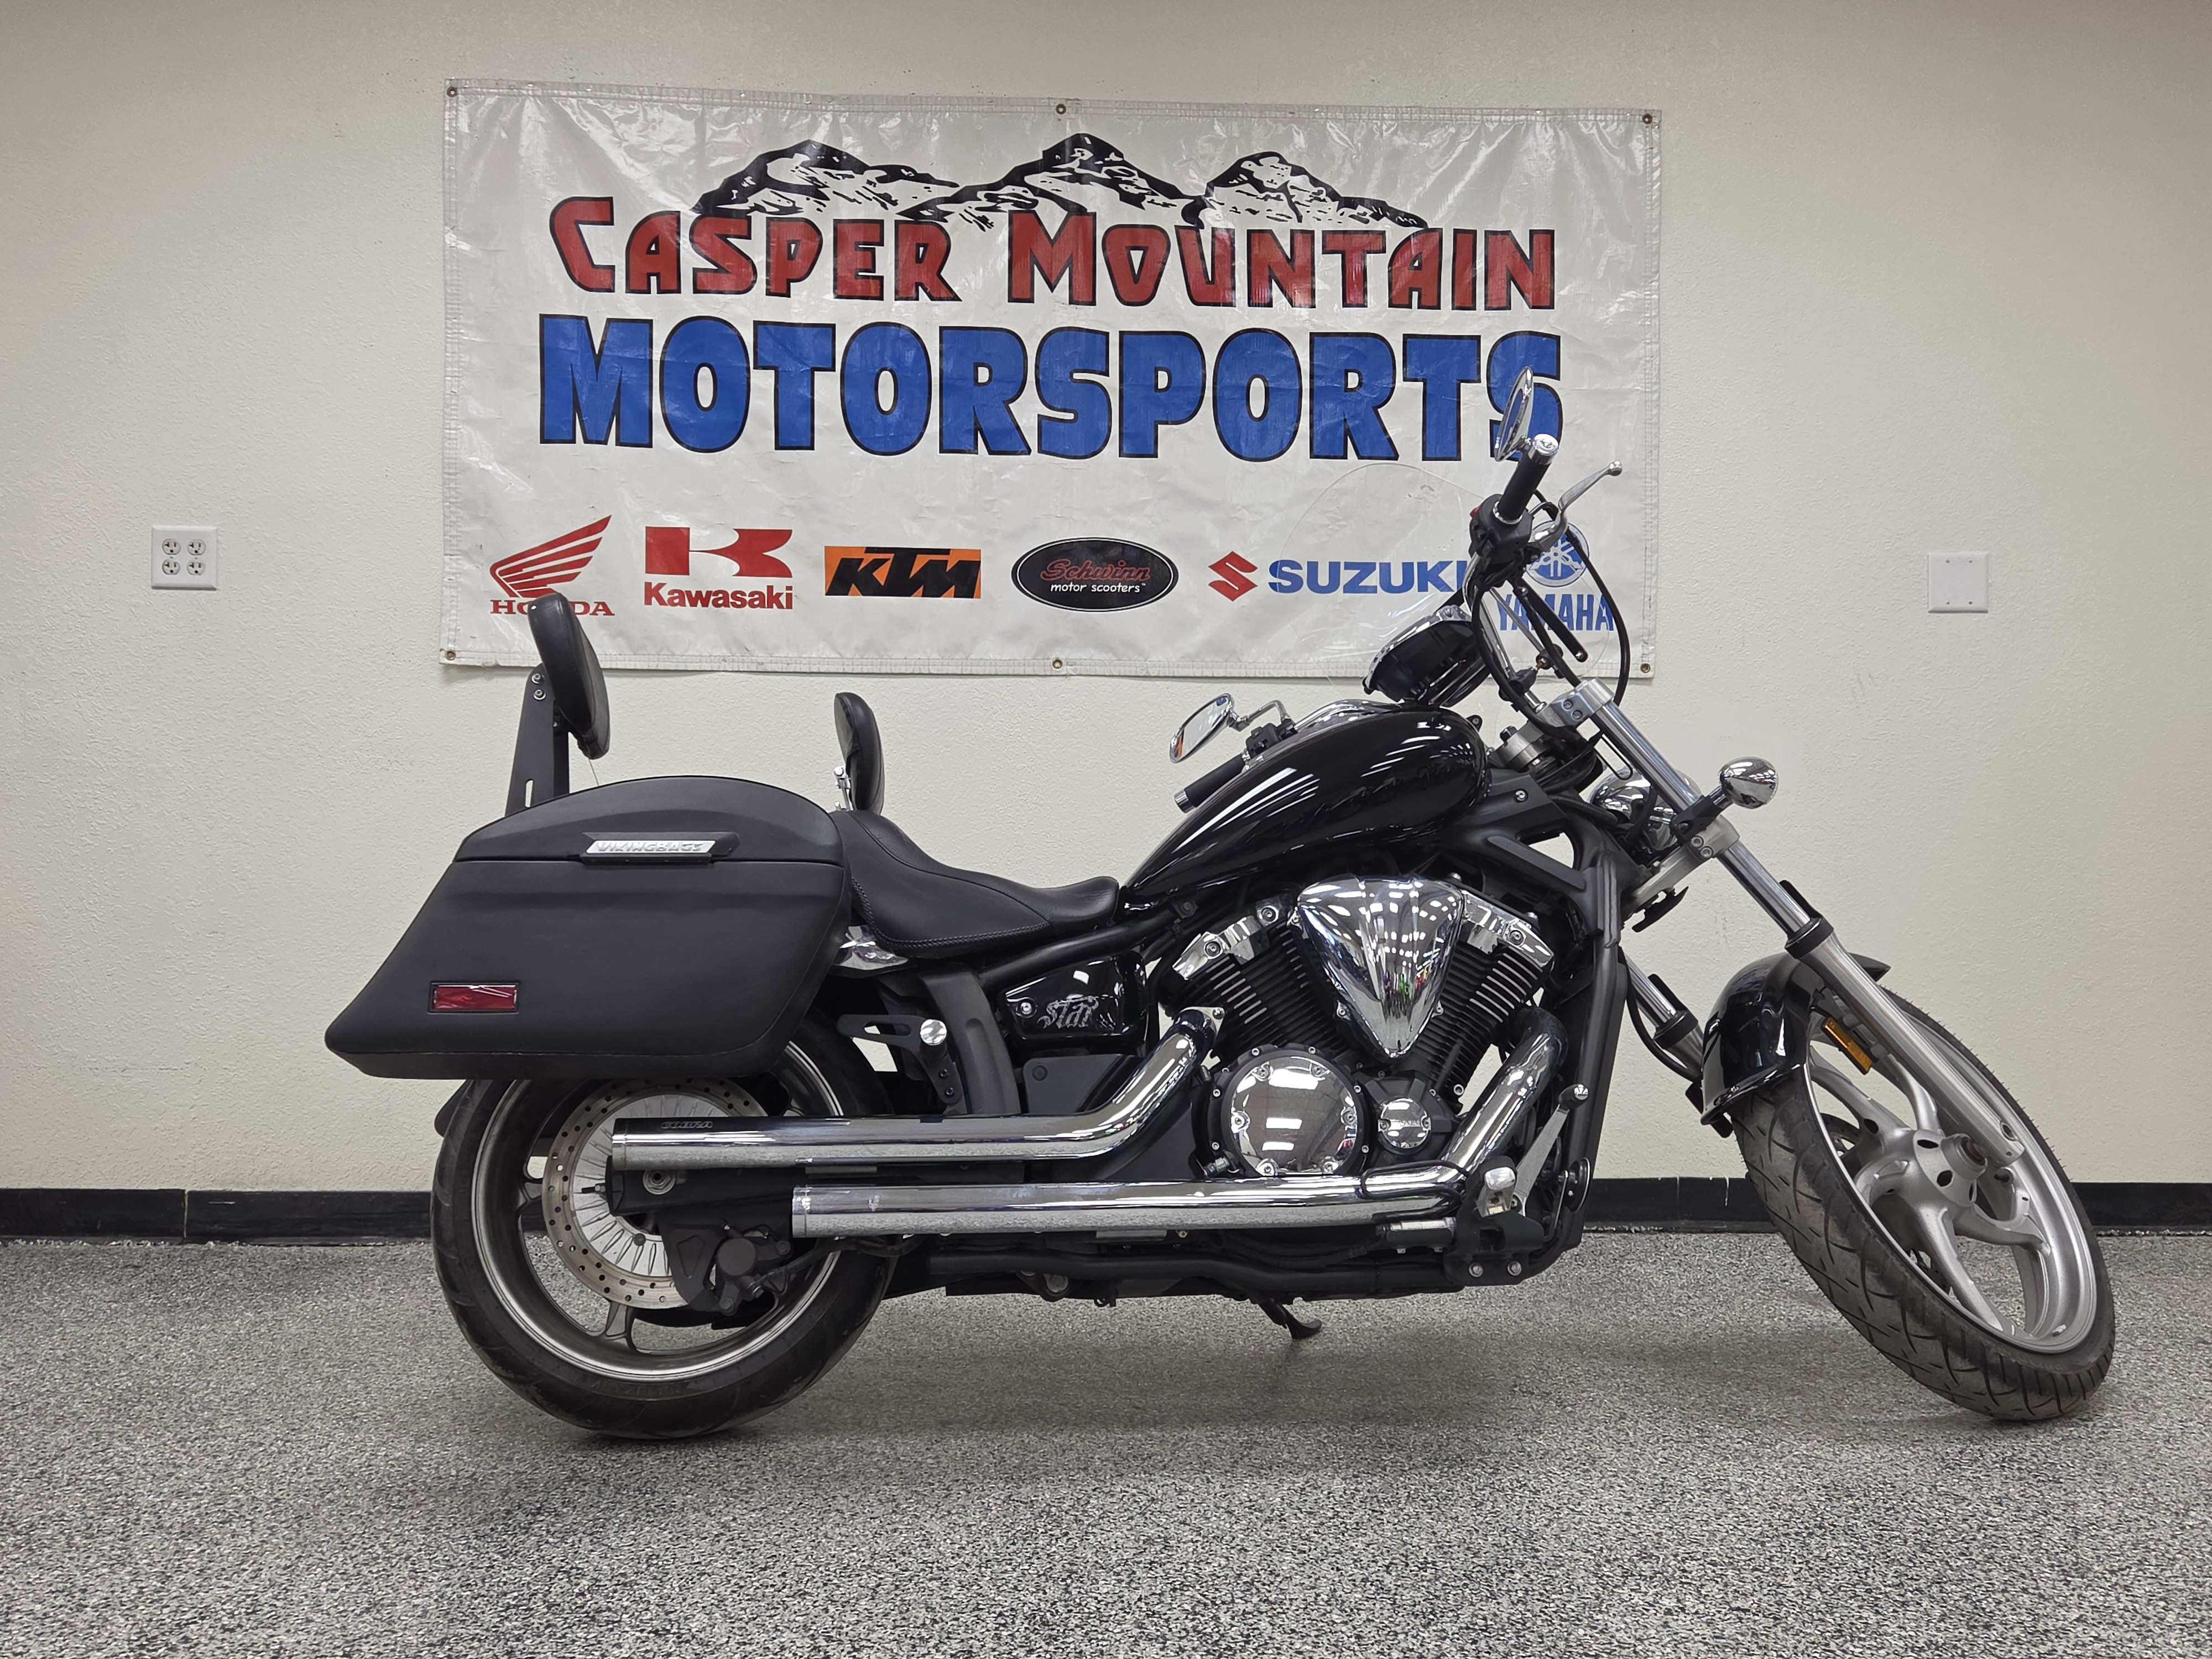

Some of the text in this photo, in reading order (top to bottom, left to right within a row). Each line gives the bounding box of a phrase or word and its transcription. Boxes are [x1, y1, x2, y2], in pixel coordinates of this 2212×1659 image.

[549, 196, 1555, 311] CASPER MOUNTAIN
[539, 313, 1563, 462] MOTORSPORTS
[825, 547, 980, 598] KTM
[1040, 559, 1151, 582] Schwinn
[1051, 582, 1087, 592] motor
[1267, 559, 1468, 594] SUZUKI
[644, 582, 794, 611] Kawasaki
